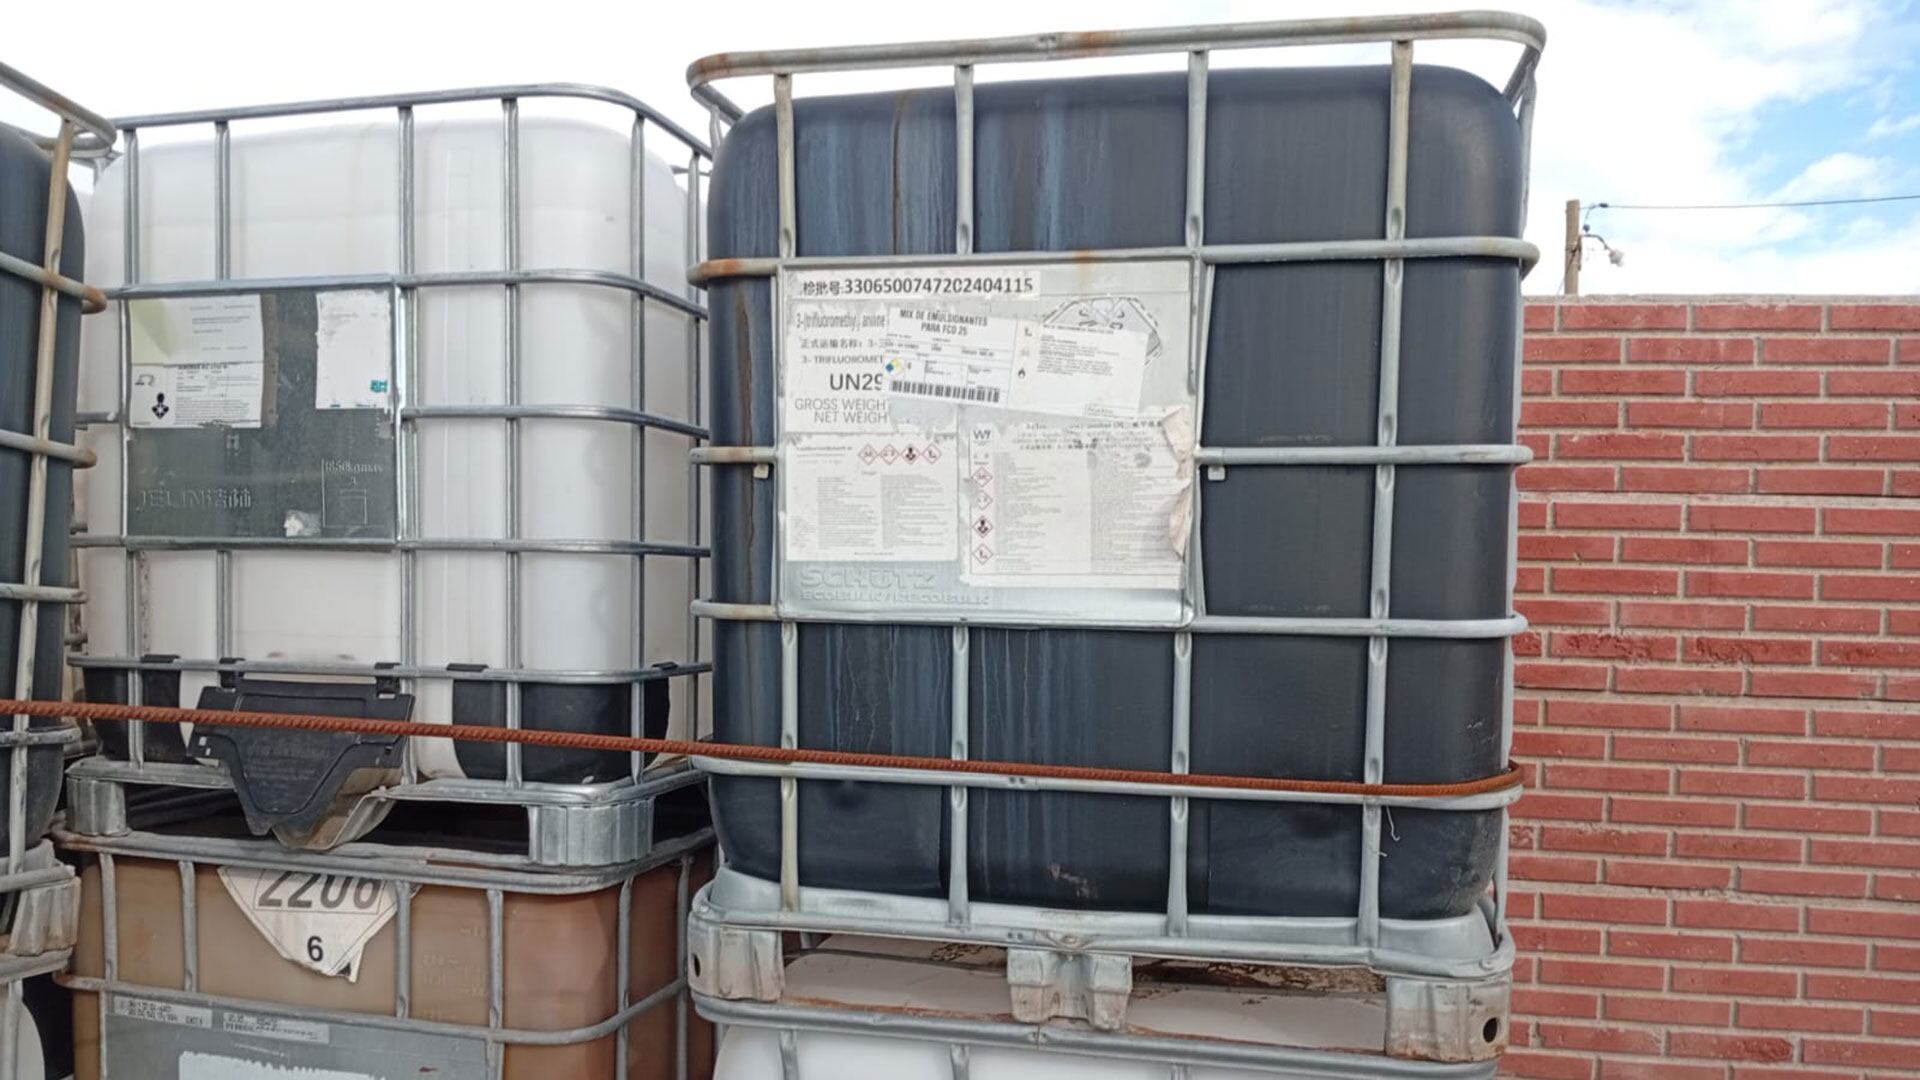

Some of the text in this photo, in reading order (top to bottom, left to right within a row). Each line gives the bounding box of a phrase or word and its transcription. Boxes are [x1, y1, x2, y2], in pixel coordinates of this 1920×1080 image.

[899, 309, 914, 319] MIX
[915, 310, 925, 320] DE
[920, 323, 941, 334] PARA
[795, 397, 838, 411] GROSS
[814, 411, 839, 423] NET
[307, 935, 324, 962] 6
